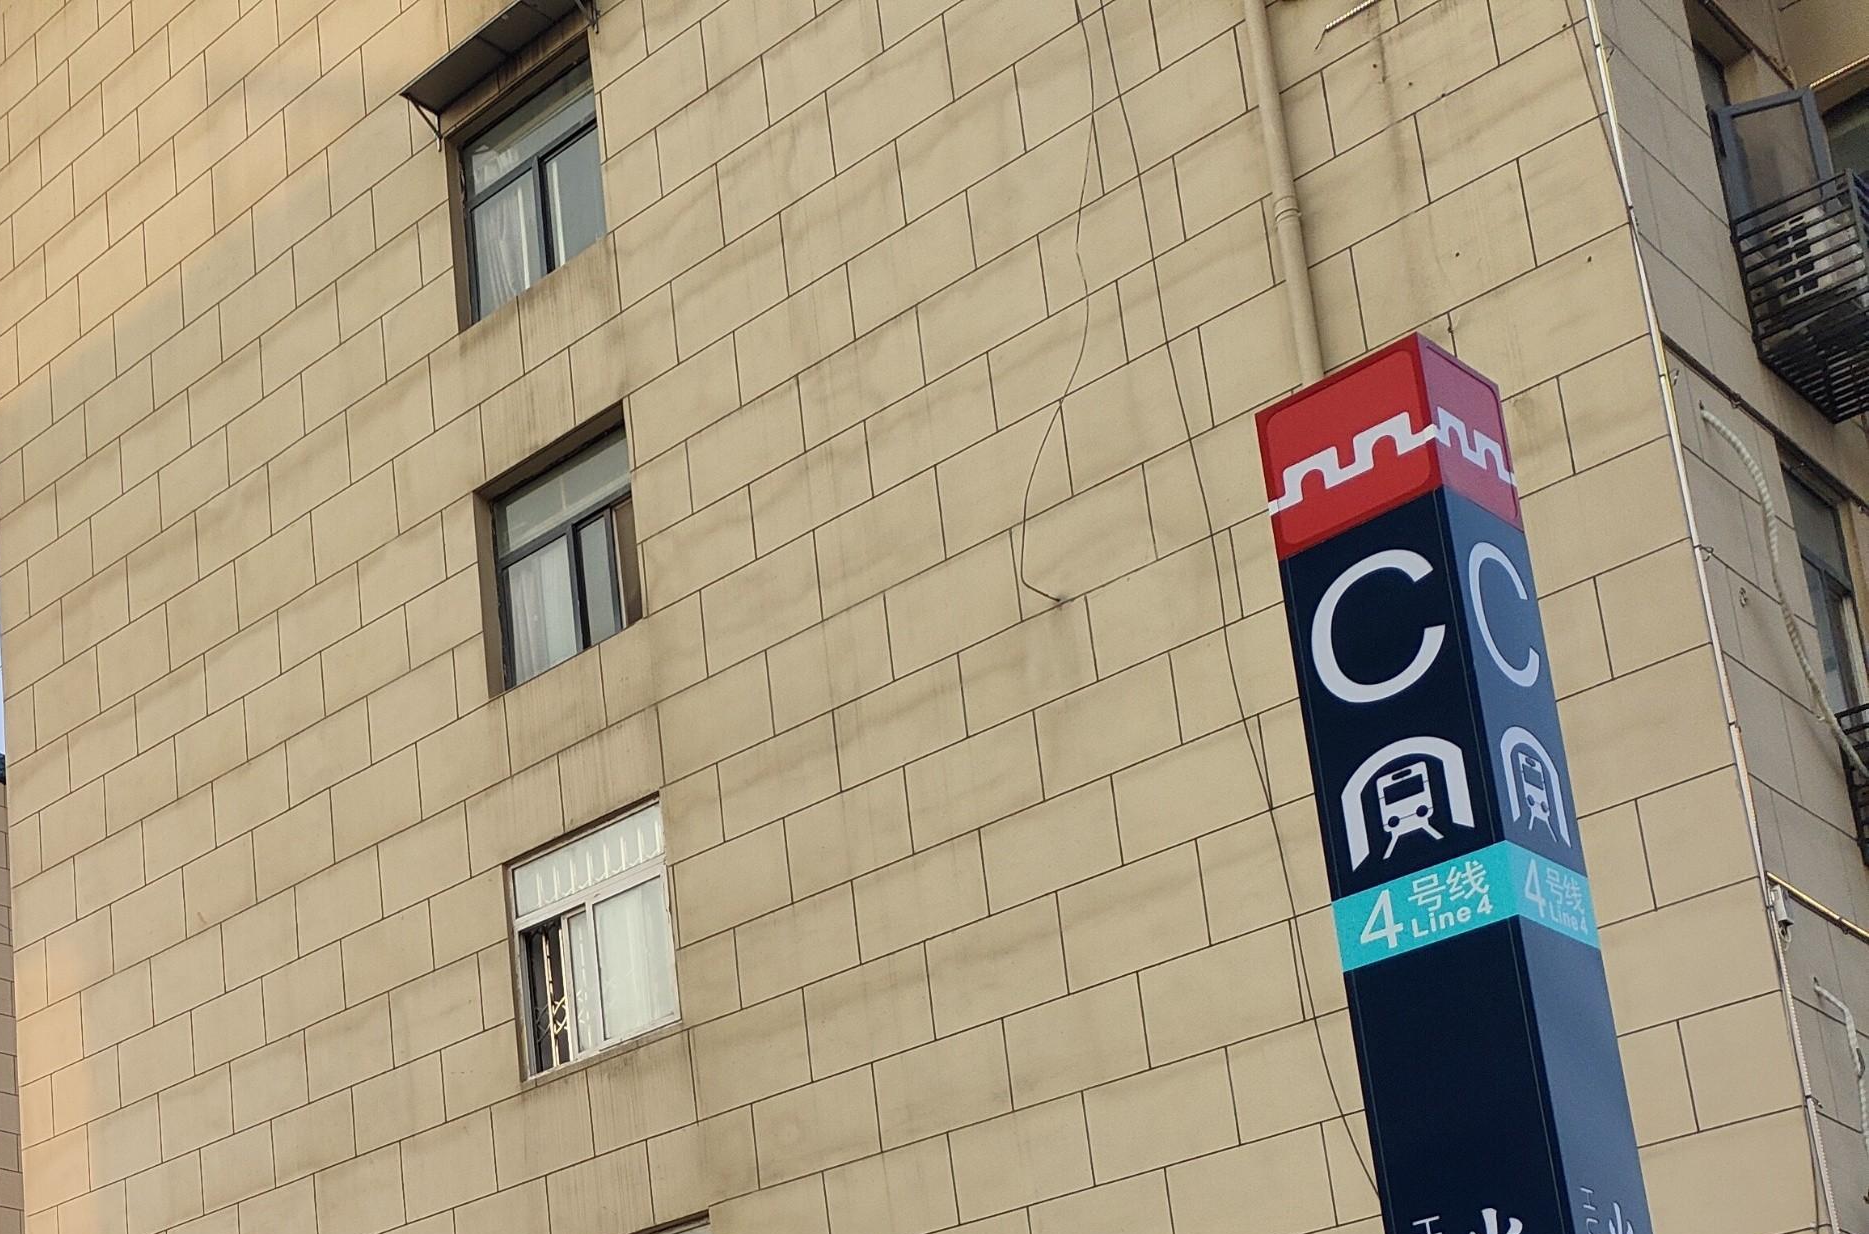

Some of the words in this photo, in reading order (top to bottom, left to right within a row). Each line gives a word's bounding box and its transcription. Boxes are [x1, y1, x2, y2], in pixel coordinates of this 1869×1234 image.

[1311, 548, 1446, 703] C
[1468, 542, 1541, 688] C
[1411, 906, 1472, 938] Line
[1477, 894, 1494, 915] 4
